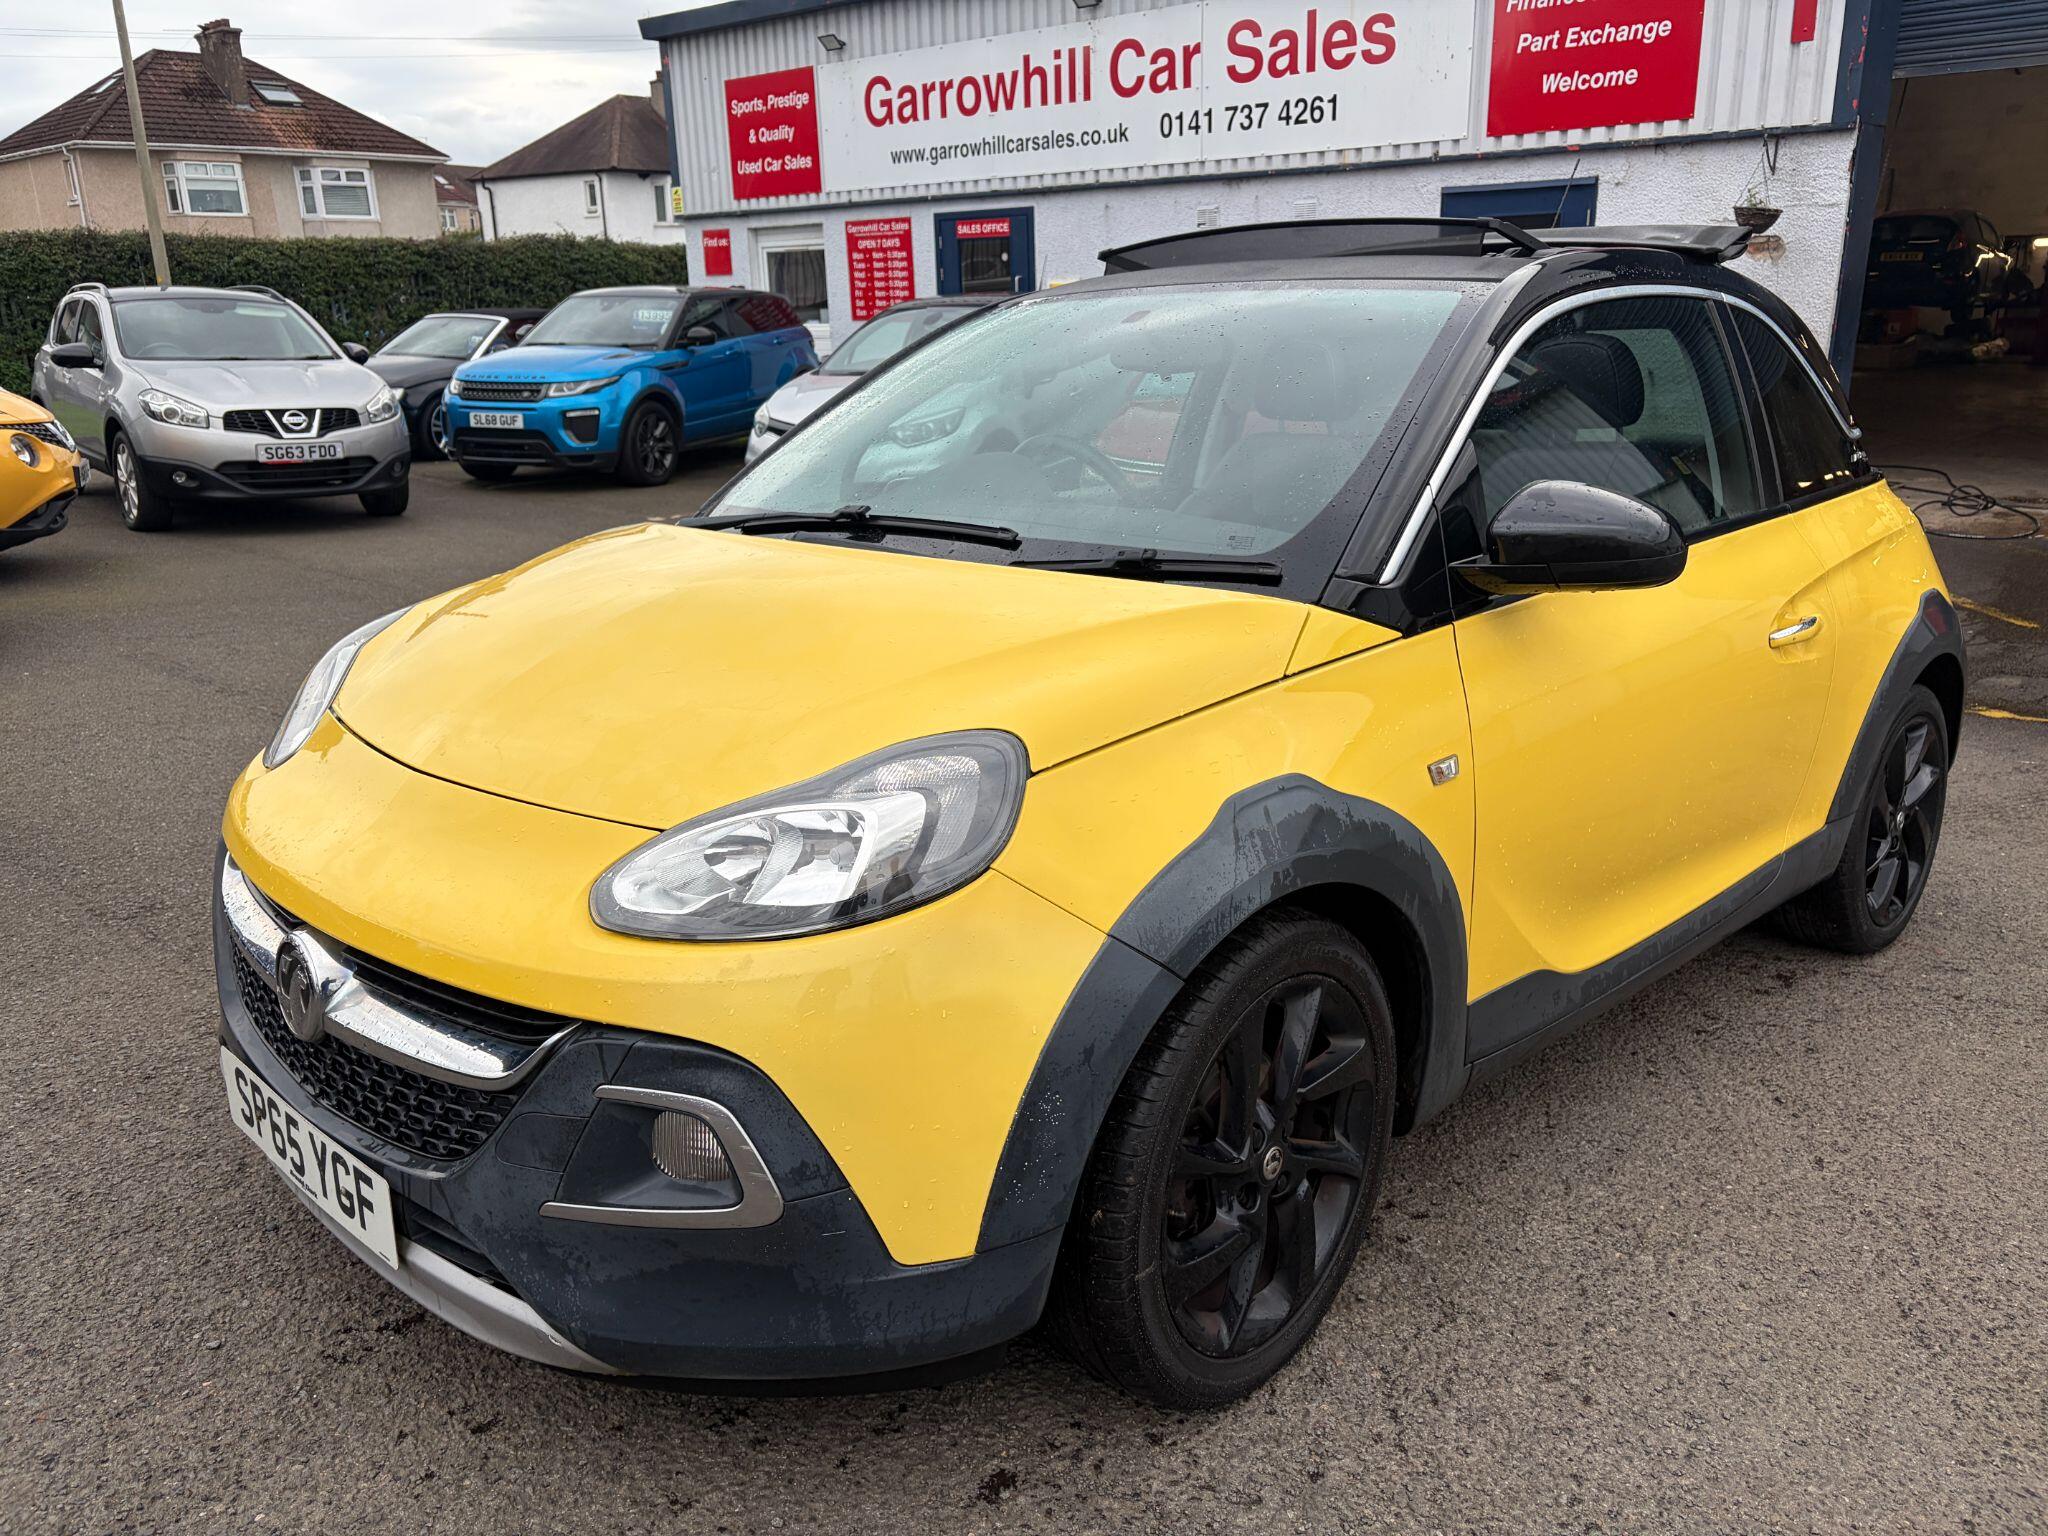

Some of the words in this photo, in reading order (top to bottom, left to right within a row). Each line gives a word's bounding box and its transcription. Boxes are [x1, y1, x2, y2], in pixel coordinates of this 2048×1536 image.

[1517, 30, 1560, 54] Part
[1564, 18, 1672, 49] Exchange
[864, 45, 1091, 128] Garrowhill
[1109, 38, 1201, 98] Car
[1226, 9, 1396, 84] Sales
[1542, 67, 1638, 94] Welcome
[731, 97, 767, 118] Sports,
[767, 90, 809, 110] Prestige
[1160, 107, 1213, 139] 0141
[1224, 102, 1269, 132] 737
[1277, 94, 1338, 127] 4261
[749, 128, 756, 143] &
[758, 124, 795, 143] Quality
[891, 122, 1129, 165] www.garrowhillcarsales.co.uk
[737, 158, 762, 175] Used
[764, 157, 782, 172] Car
[784, 154, 813, 170] Sales
[957, 224, 981, 234] SALES
[982, 222, 1009, 233] OFFICE
[857, 240, 876, 249] OPEN
[882, 238, 900, 248] DAYS
[473, 414, 498, 426] SL68
[499, 414, 519, 426] GUF
[264, 446, 304, 460] SG63
[308, 444, 337, 459] FDO
[234, 1067, 306, 1179] SP65
[308, 1130, 375, 1232] YGF
